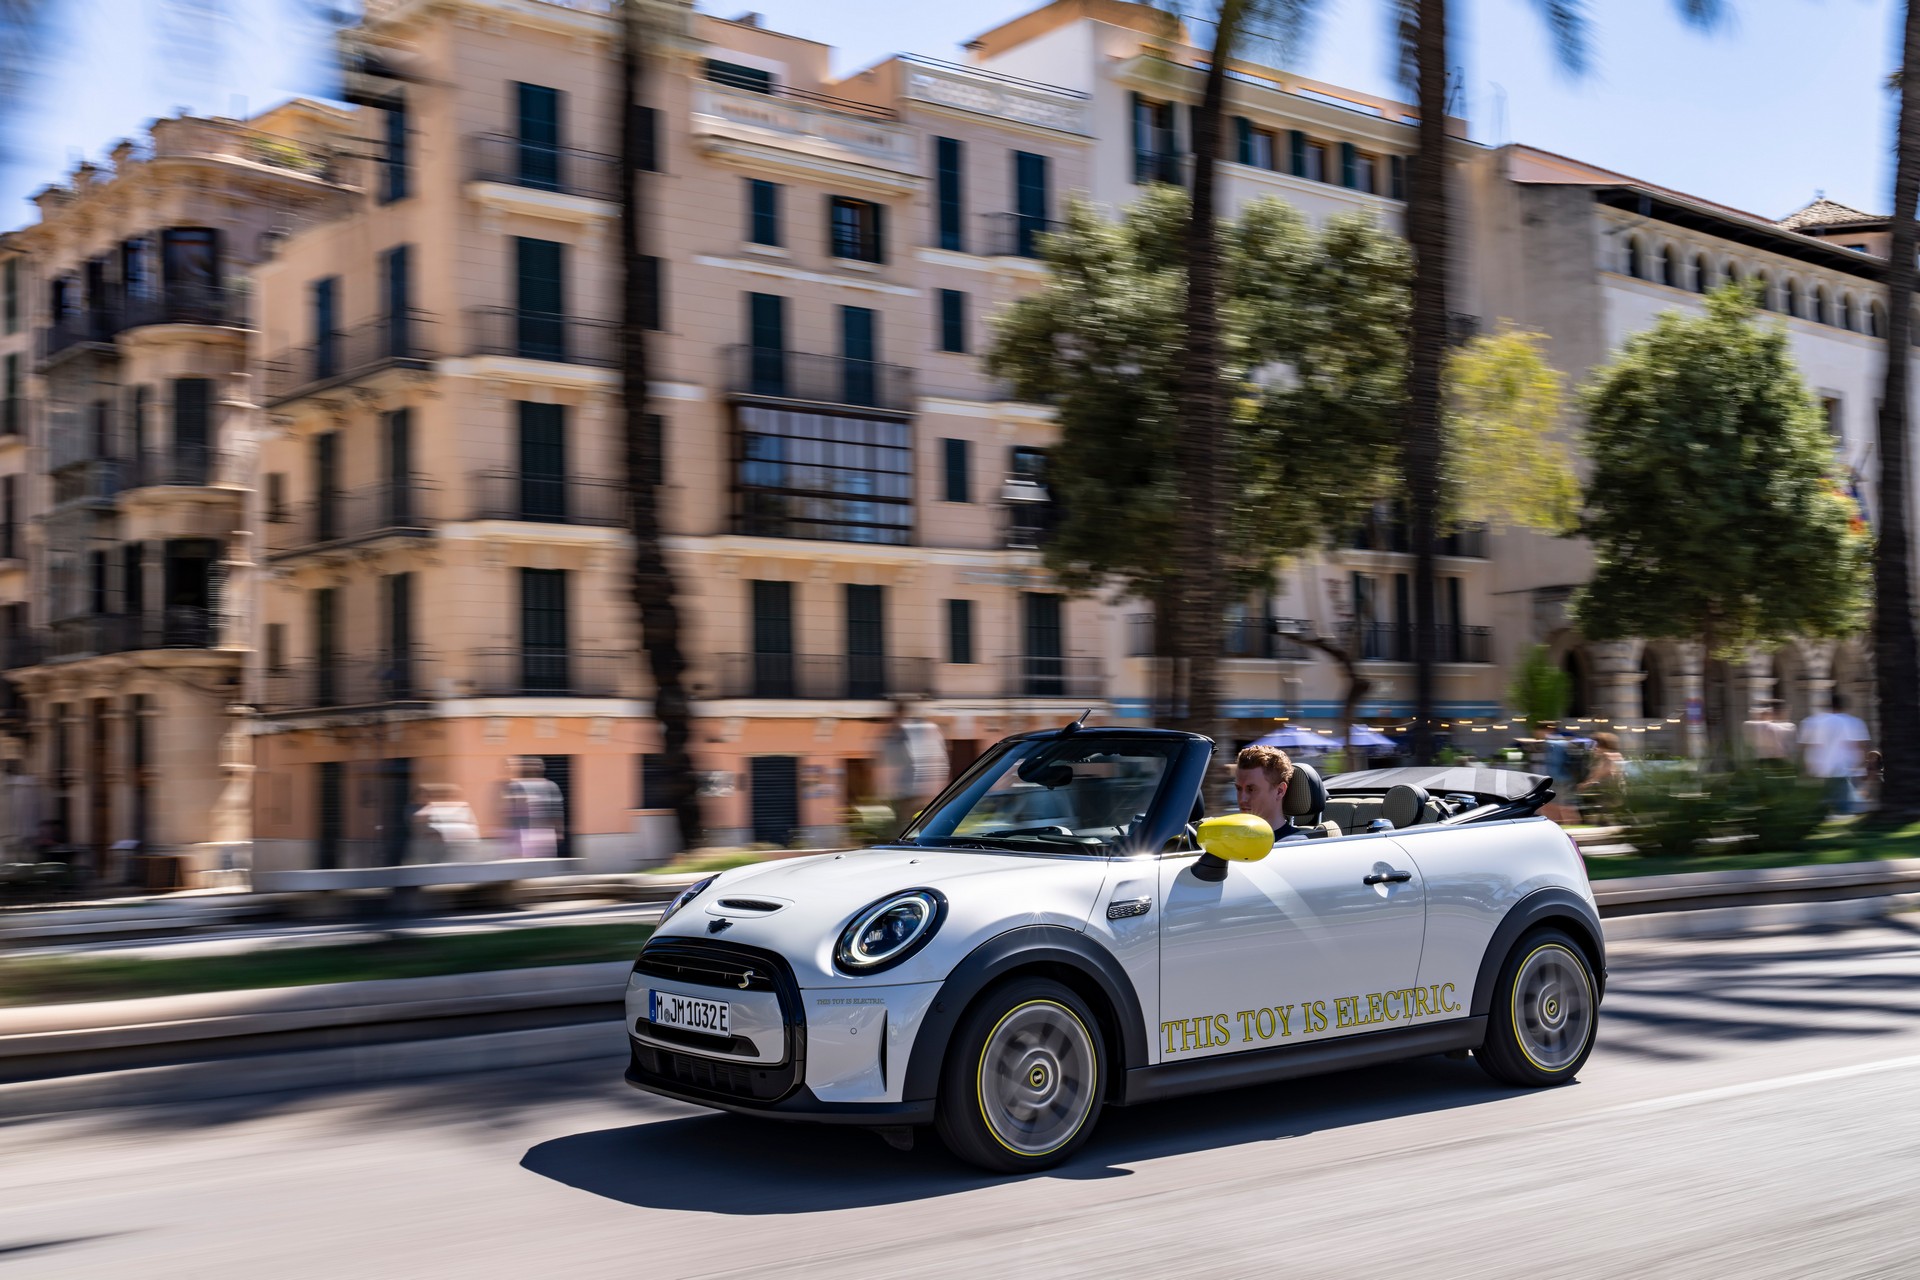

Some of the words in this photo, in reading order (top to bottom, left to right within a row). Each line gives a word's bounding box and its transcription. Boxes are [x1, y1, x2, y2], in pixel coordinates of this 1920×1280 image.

[737, 970, 754, 988] S
[656, 995, 663, 1020] M
[1161, 1013, 1230, 1053] THIS
[1236, 1004, 1294, 1042] TOY
[1301, 1000, 1328, 1034] IS
[1333, 982, 1461, 1029] ELECTRIC.
